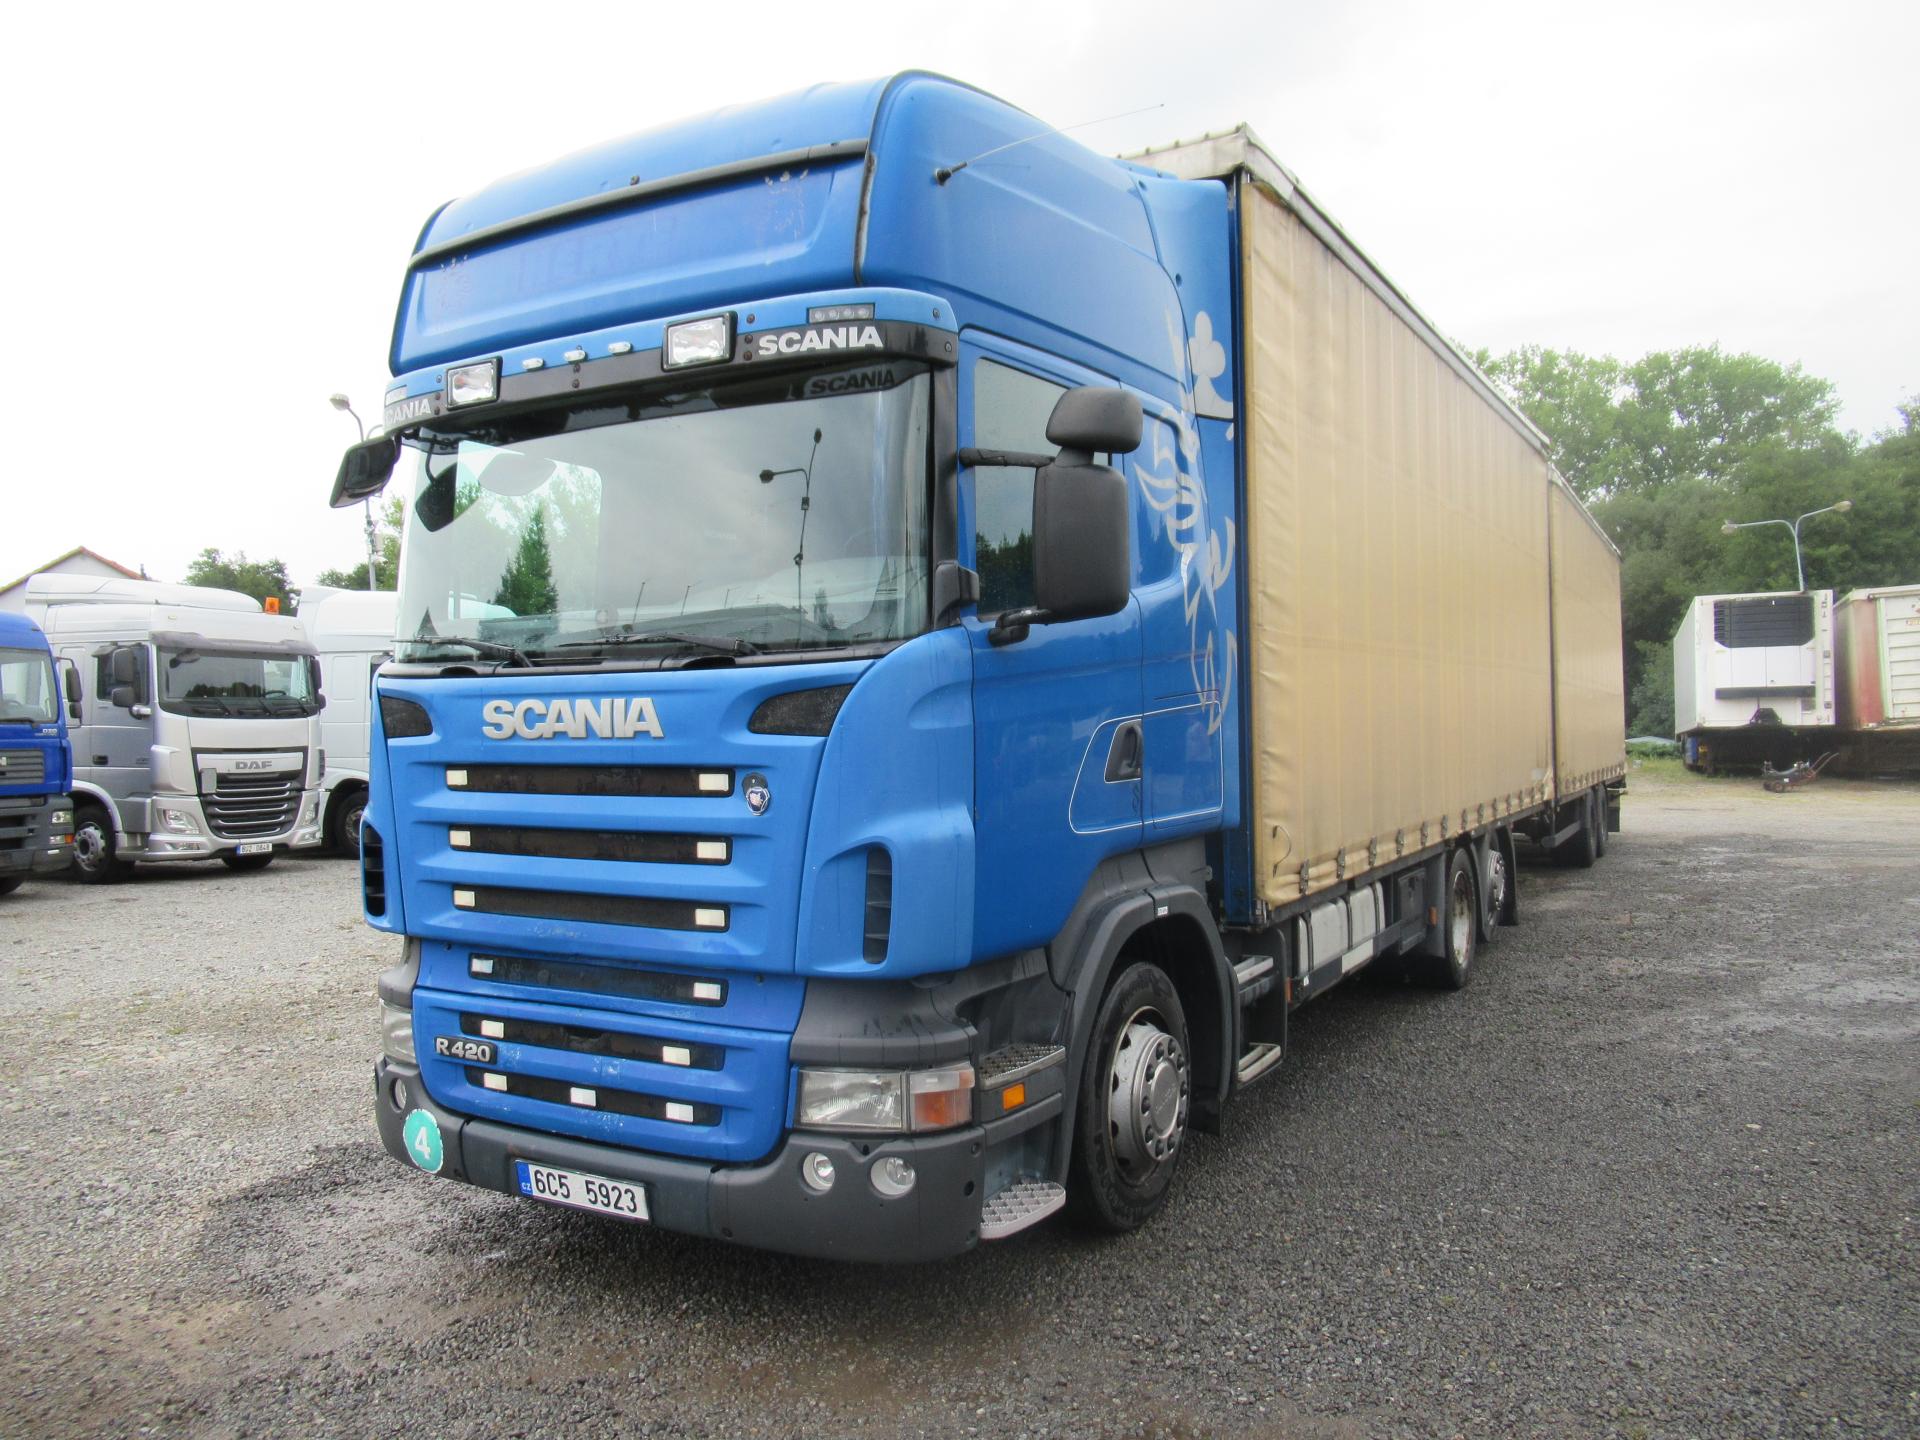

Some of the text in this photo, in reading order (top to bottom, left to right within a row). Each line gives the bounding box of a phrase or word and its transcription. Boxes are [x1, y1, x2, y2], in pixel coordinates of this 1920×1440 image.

[758, 325, 884, 355] SCANIA
[810, 368, 896, 396] SCANIA
[384, 398, 432, 425] CANIA
[482, 697, 665, 740] SCANIA
[235, 760, 272, 770] DAF
[436, 1037, 491, 1062] R 420
[414, 1126, 431, 1160] 4
[521, 1169, 637, 1213] CZ 6C5 5923
